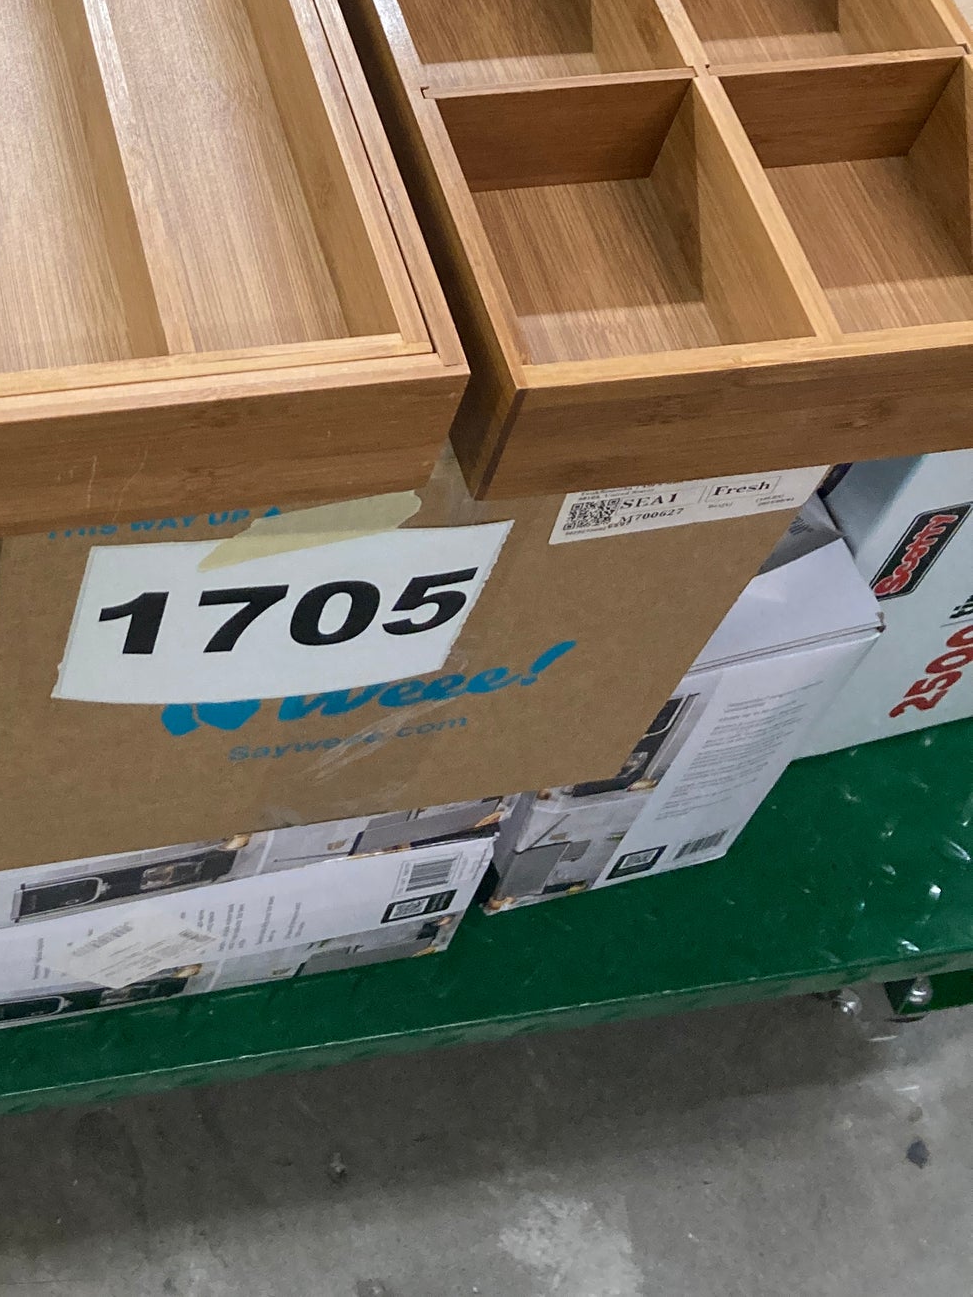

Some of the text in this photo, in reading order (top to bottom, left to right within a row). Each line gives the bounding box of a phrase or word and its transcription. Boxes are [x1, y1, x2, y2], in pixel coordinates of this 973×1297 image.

[713, 482, 771, 496] Fresh
[130, 515, 197, 532] WAY
[208, 509, 250, 526] UP
[874, 514, 959, 596] Scotty
[98, 567, 479, 655] 1705
